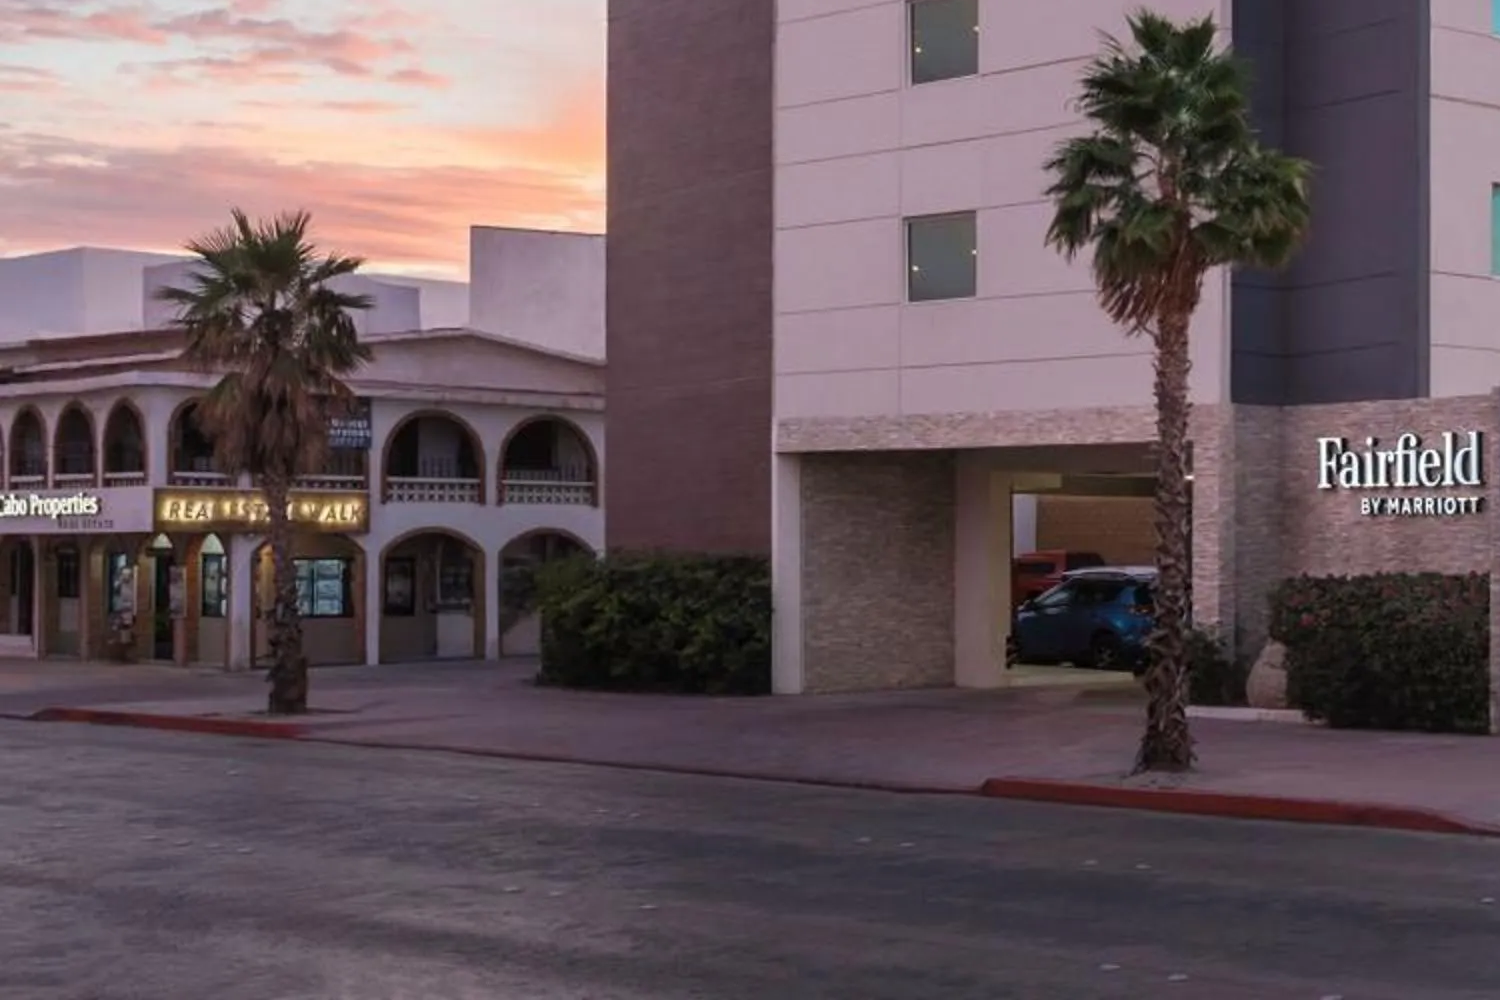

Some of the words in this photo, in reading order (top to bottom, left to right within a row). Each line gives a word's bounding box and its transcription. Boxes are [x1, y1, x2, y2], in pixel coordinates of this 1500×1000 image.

[1317, 430, 1482, 489] Fairfield
[30, 492, 98, 519] Properties
[1361, 497, 1381, 515] BY
[1386, 496, 1481, 515] MARRIOTT
